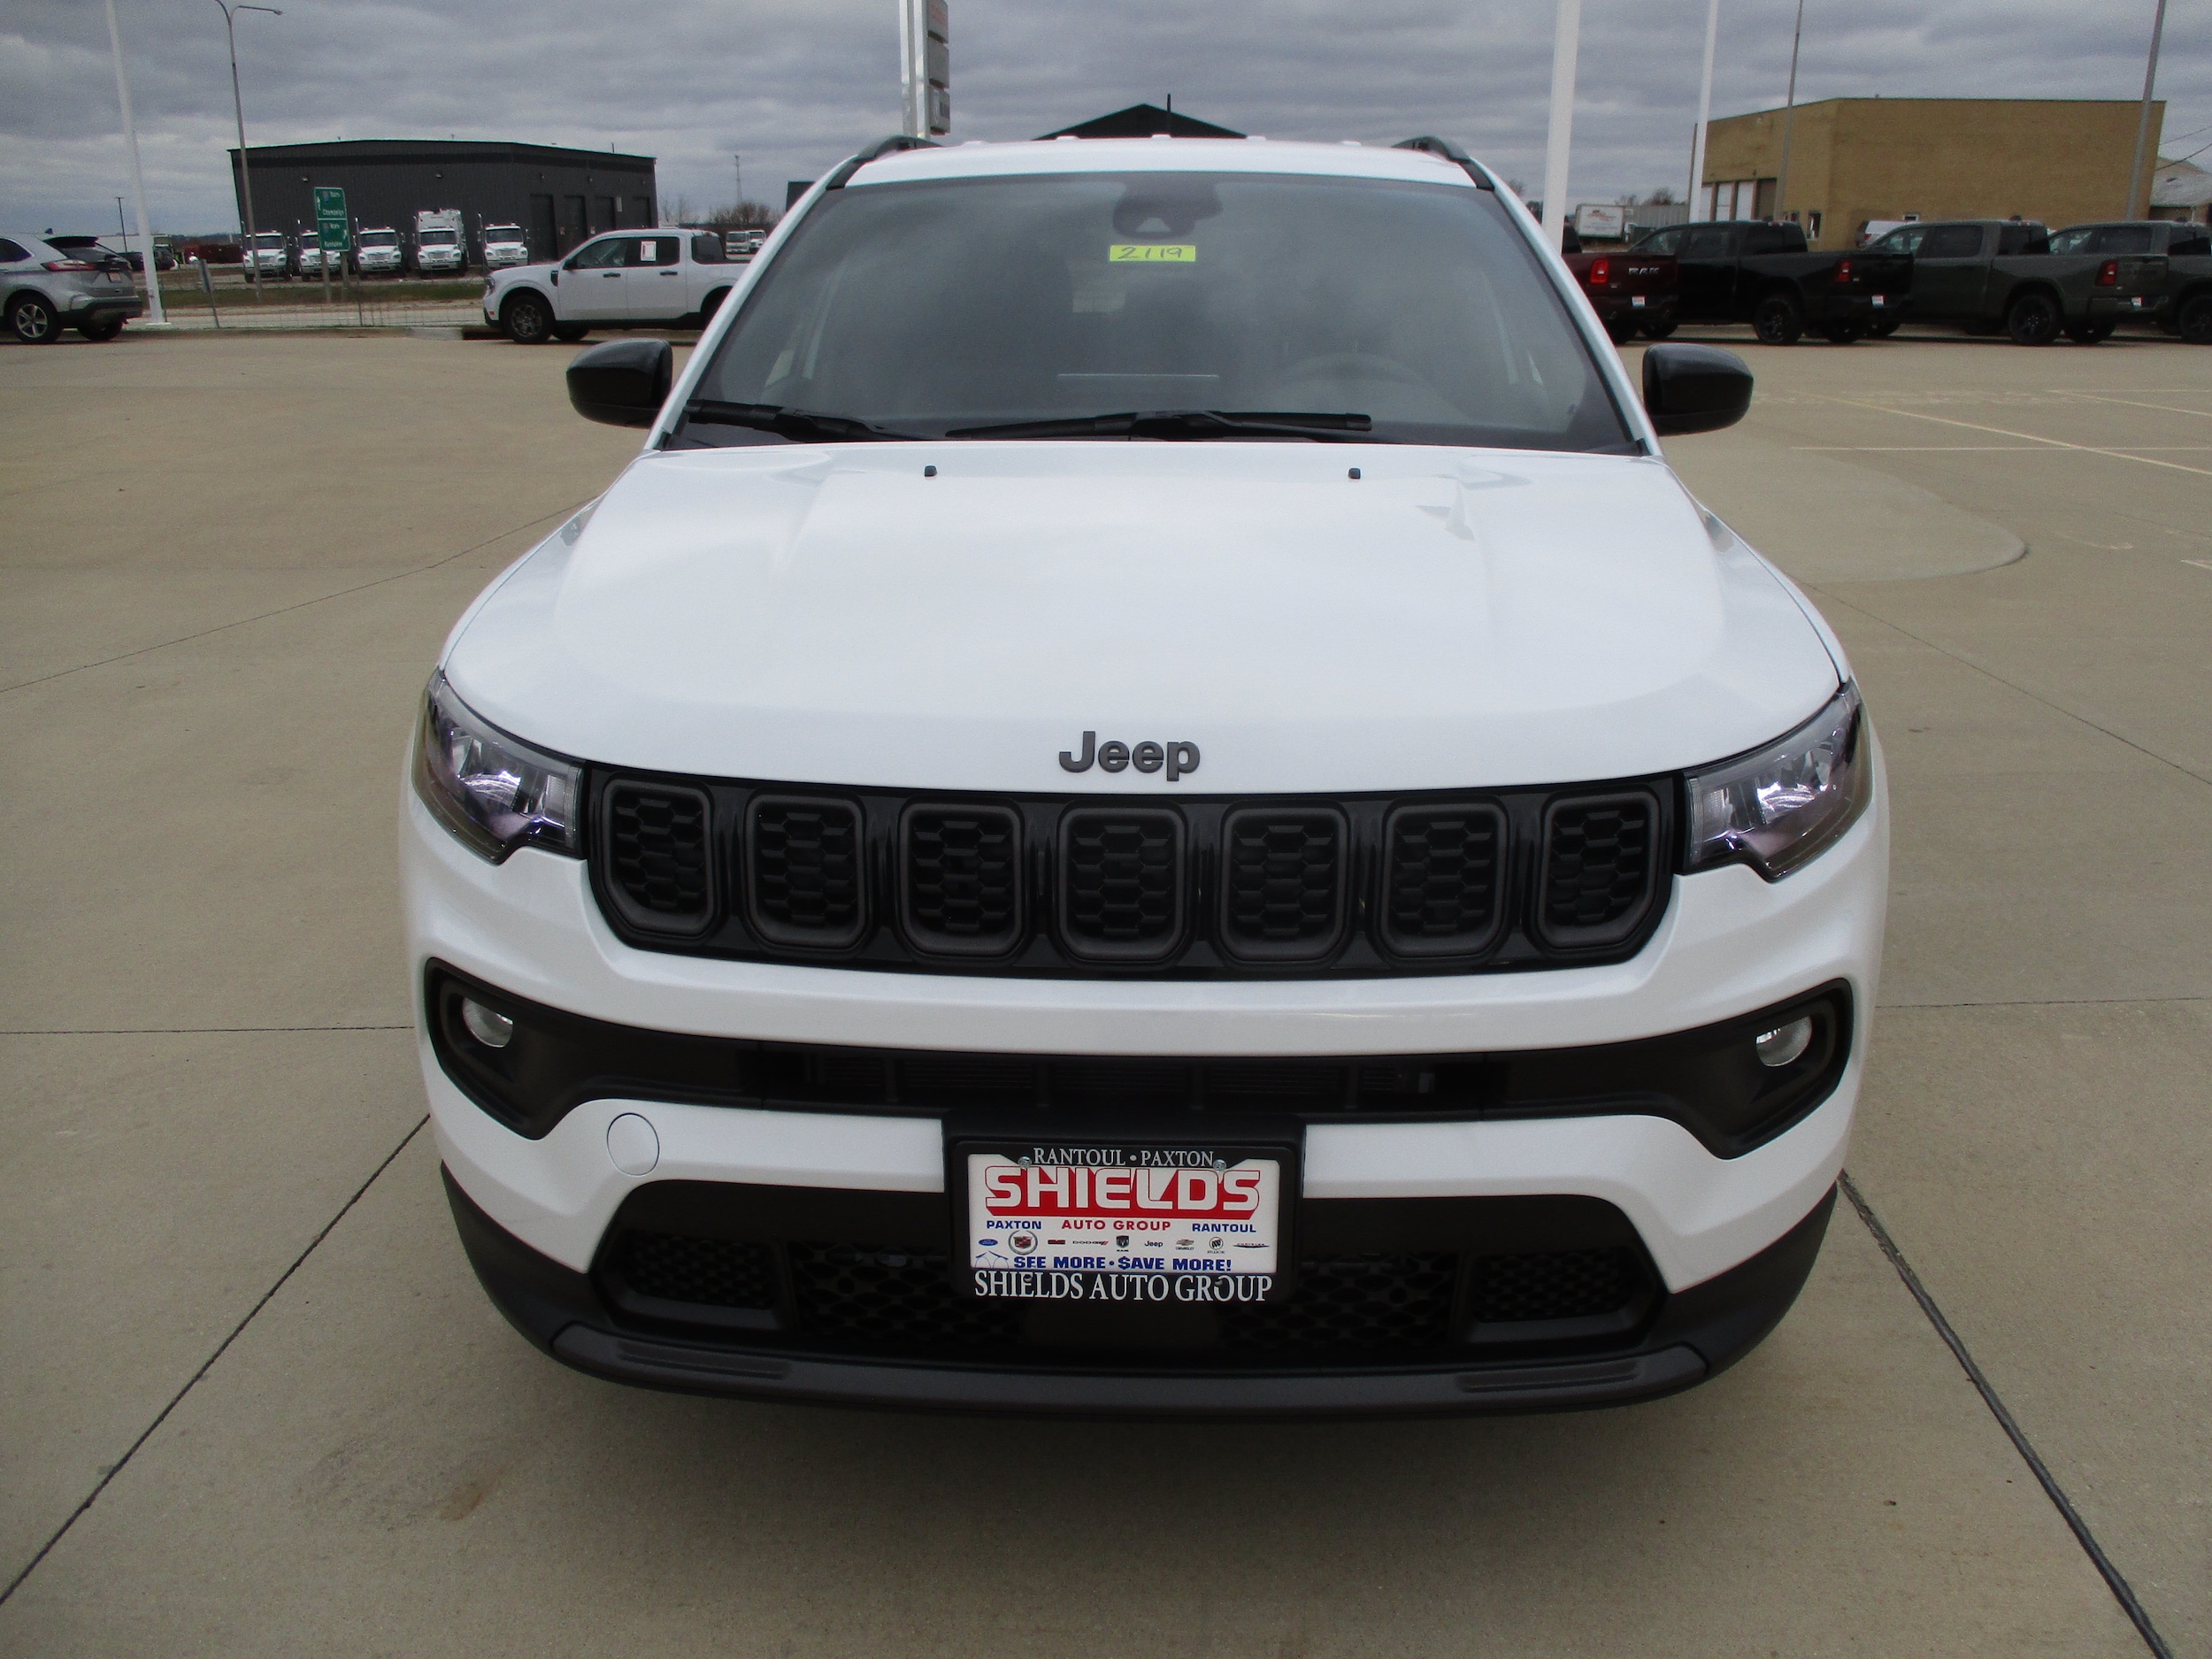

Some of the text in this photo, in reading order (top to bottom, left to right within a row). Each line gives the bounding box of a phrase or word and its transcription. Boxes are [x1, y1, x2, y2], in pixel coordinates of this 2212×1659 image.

[1118, 247, 1182, 259] 2119
[1059, 731, 1201, 781] Jeep
[1033, 1148, 1214, 1167] RANTOUL PAXTON
[985, 1165, 1261, 1218] SHIELDS
[1062, 1220, 1171, 1231] AUTO GROUP
[1192, 1223, 1256, 1233] RANTOUL
[1014, 1256, 1232, 1271] SEE MORE $AVE MORE!
[975, 1271, 1273, 1302] SHIELDS AUTO GROUP
